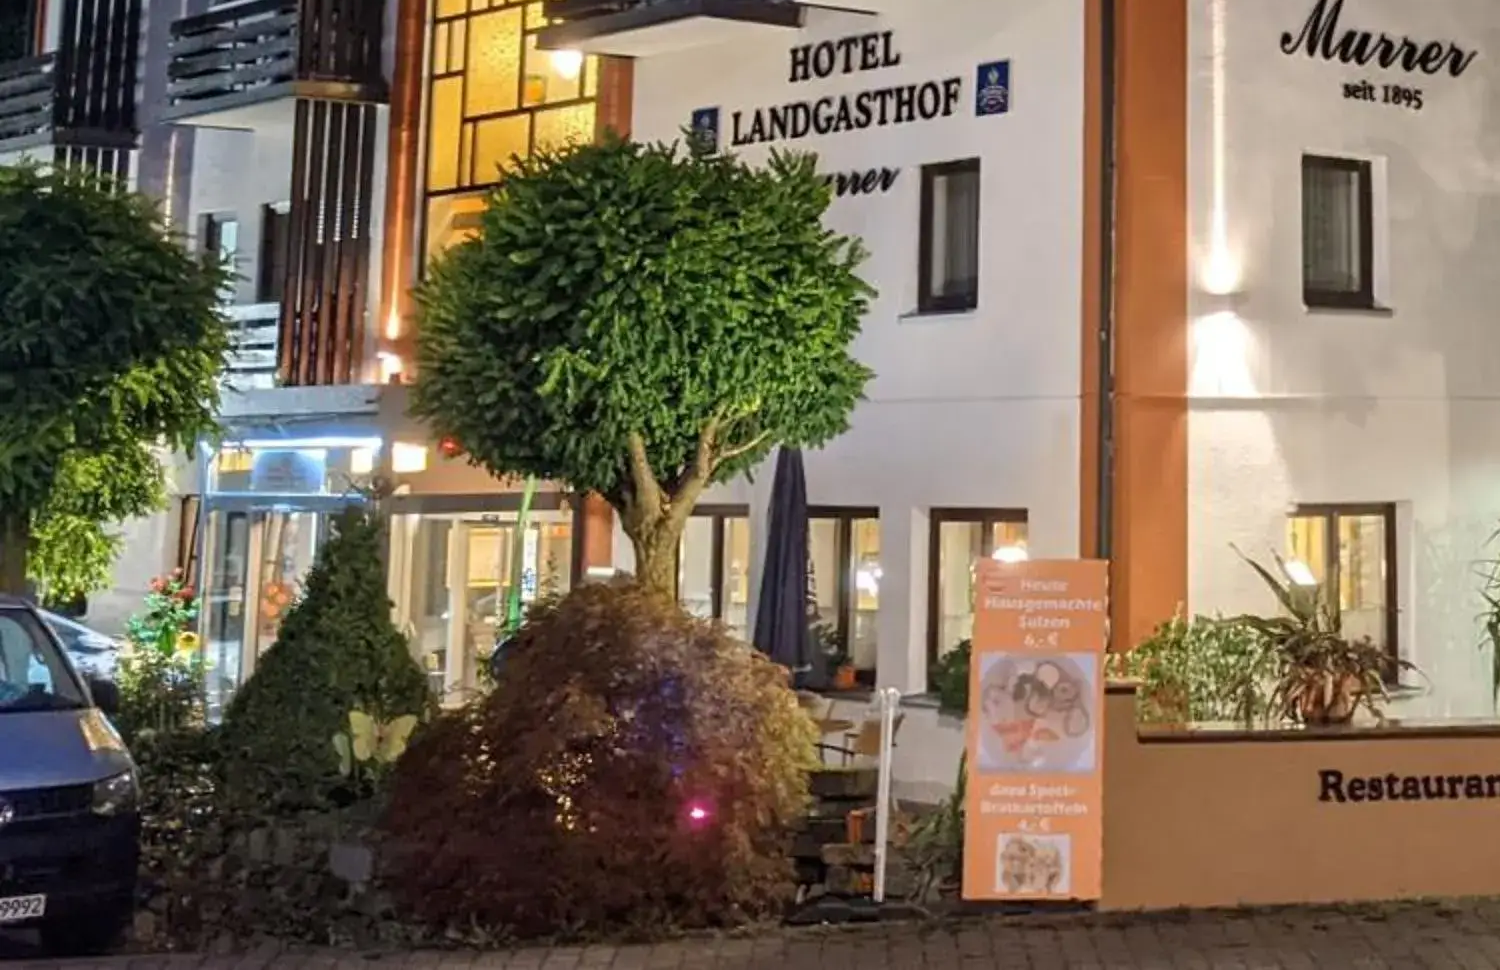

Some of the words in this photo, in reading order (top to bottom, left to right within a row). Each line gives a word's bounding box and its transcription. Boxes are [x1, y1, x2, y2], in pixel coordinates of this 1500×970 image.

[788, 30, 902, 83] HOTEL
[731, 76, 962, 146] LANDGASTHOF
[1342, 79, 1376, 103] seit
[1381, 85, 1424, 111] 1895
[822, 166, 901, 198] rrer
